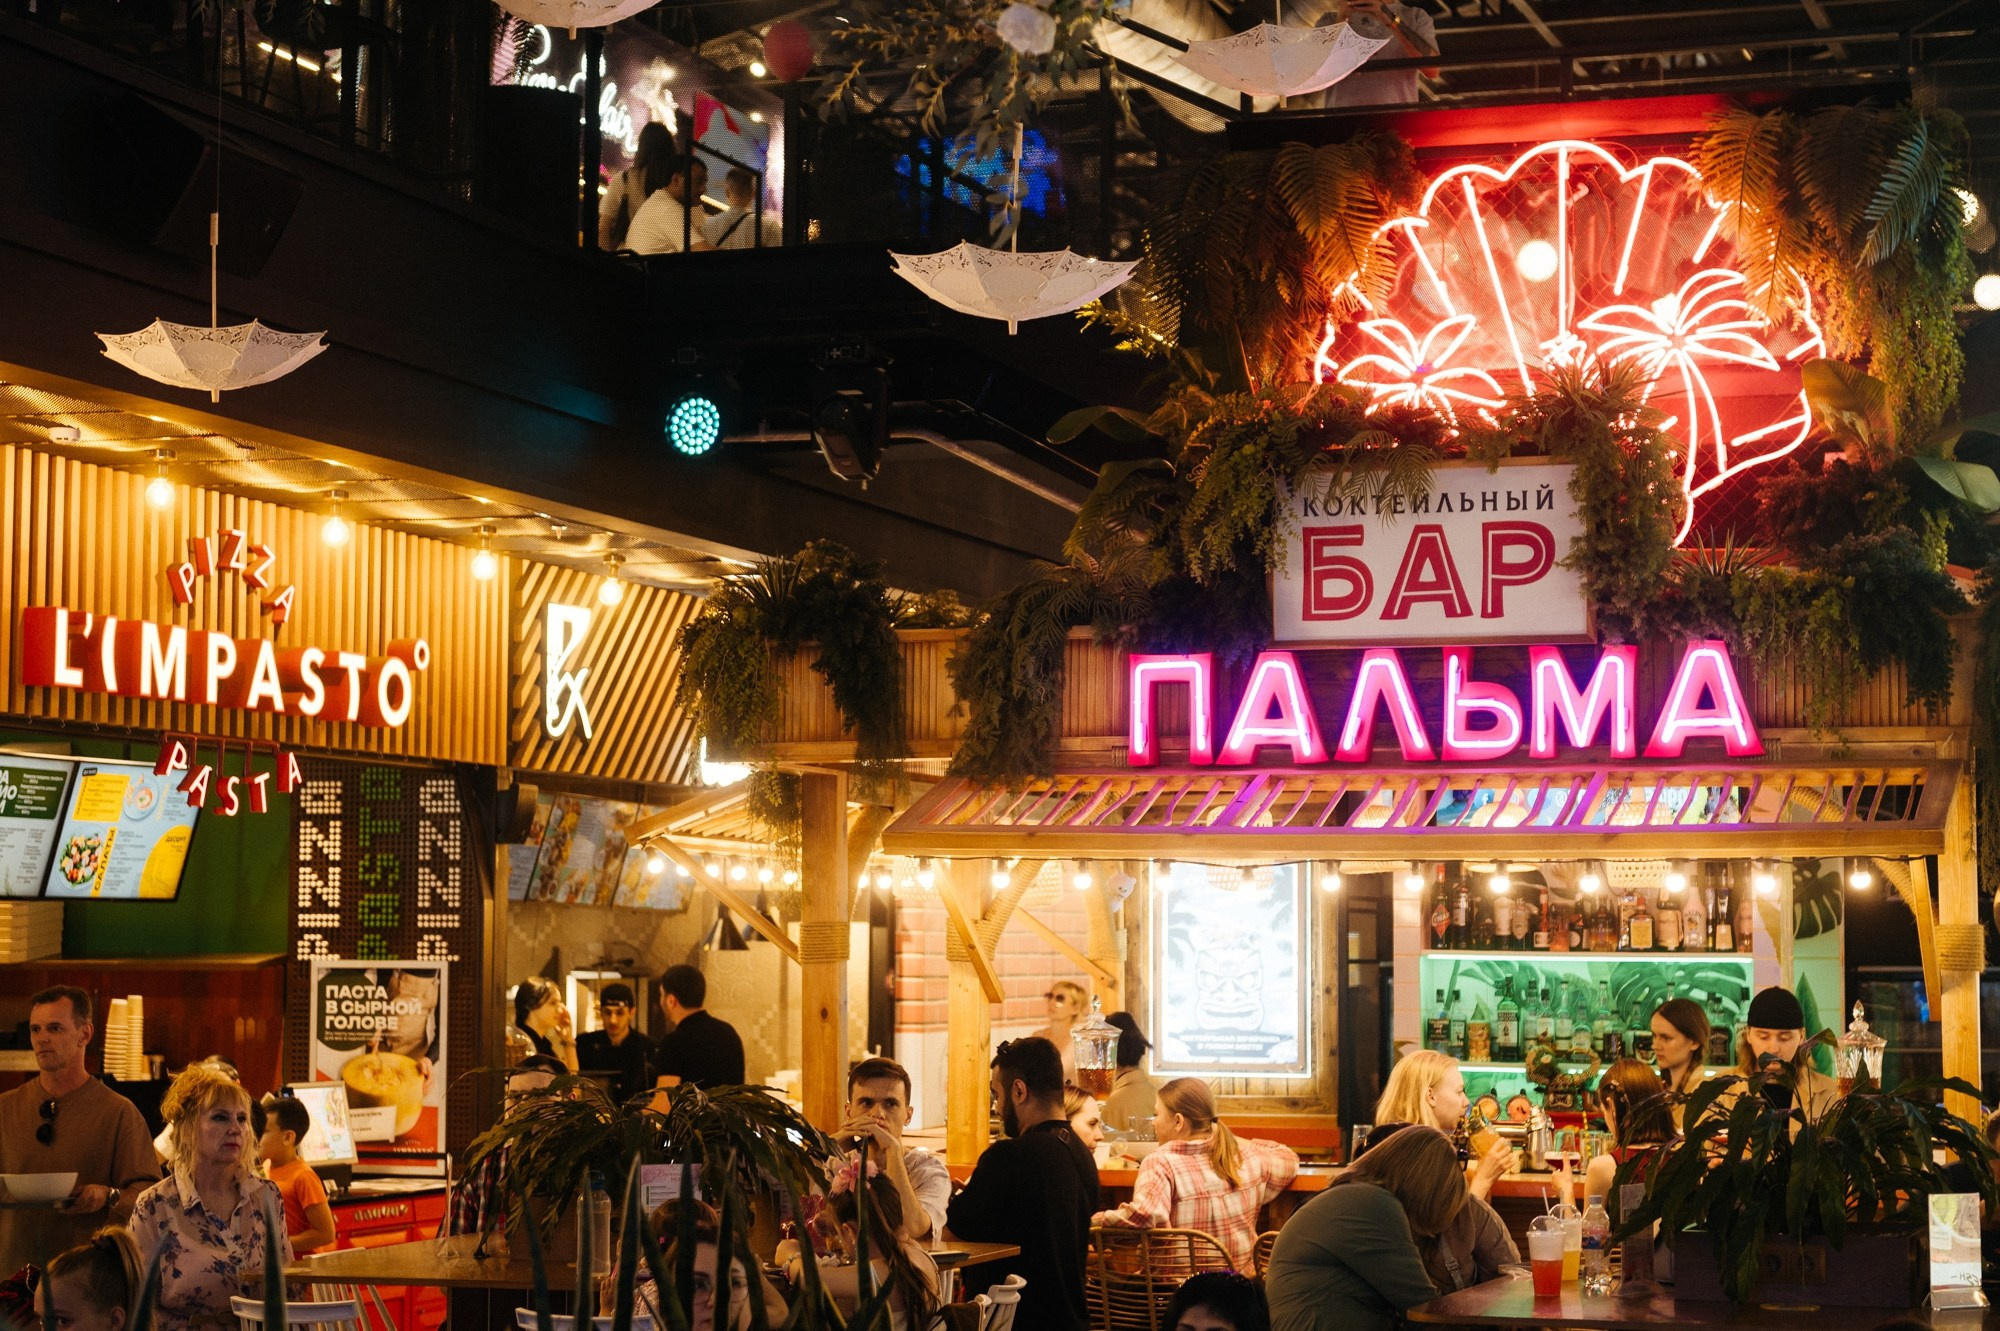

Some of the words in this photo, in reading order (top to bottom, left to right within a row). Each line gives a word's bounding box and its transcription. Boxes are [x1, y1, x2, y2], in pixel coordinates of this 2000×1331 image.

[178, 528, 296, 624] PIZZA
[1302, 520, 1556, 621] БАР
[1128, 640, 1766, 767] ПАЛЬМА
[163, 740, 304, 818] PASTA
[324, 1015, 399, 1031] ГОЛОВЕ
[325, 984, 389, 1000] ПАСТА
[325, 1000, 339, 1015] В
[340, 997, 423, 1016] СЫРНОЙ
